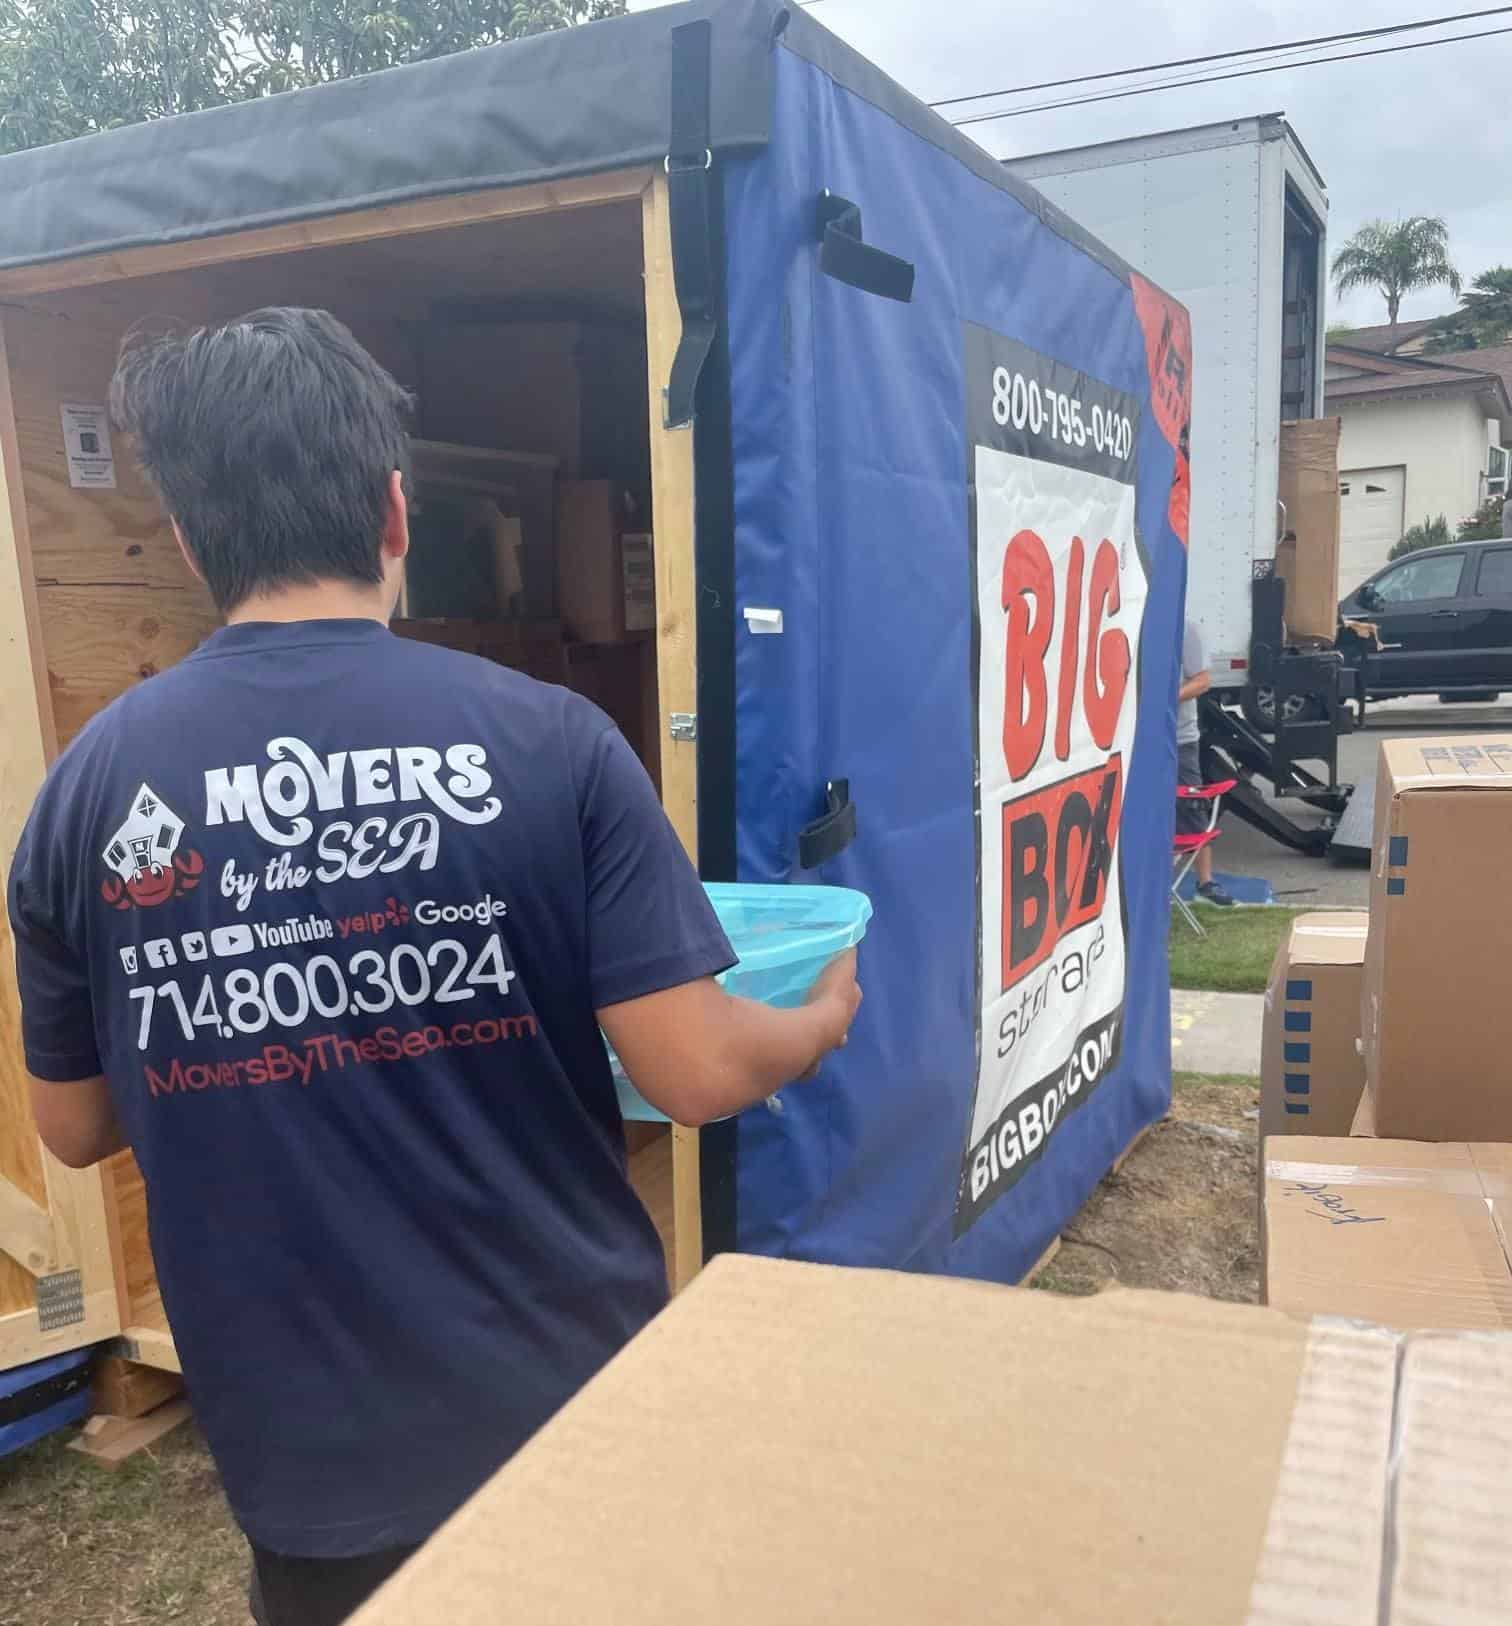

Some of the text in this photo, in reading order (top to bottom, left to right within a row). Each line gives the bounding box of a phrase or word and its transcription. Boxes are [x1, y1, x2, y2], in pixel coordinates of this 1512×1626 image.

[992, 366, 1132, 461] 800-795-0420
[1002, 529, 1131, 783] BIG
[204, 736, 503, 846] MOVERS
[220, 813, 440, 911] by the SEA
[1010, 771, 1118, 971] BOX
[253, 915, 334, 948] YouTube
[336, 909, 386, 939] yelp
[414, 894, 507, 926] Google
[128, 933, 516, 1051] 714.800.3024
[143, 1014, 537, 1097] MoversByTheSea.com
